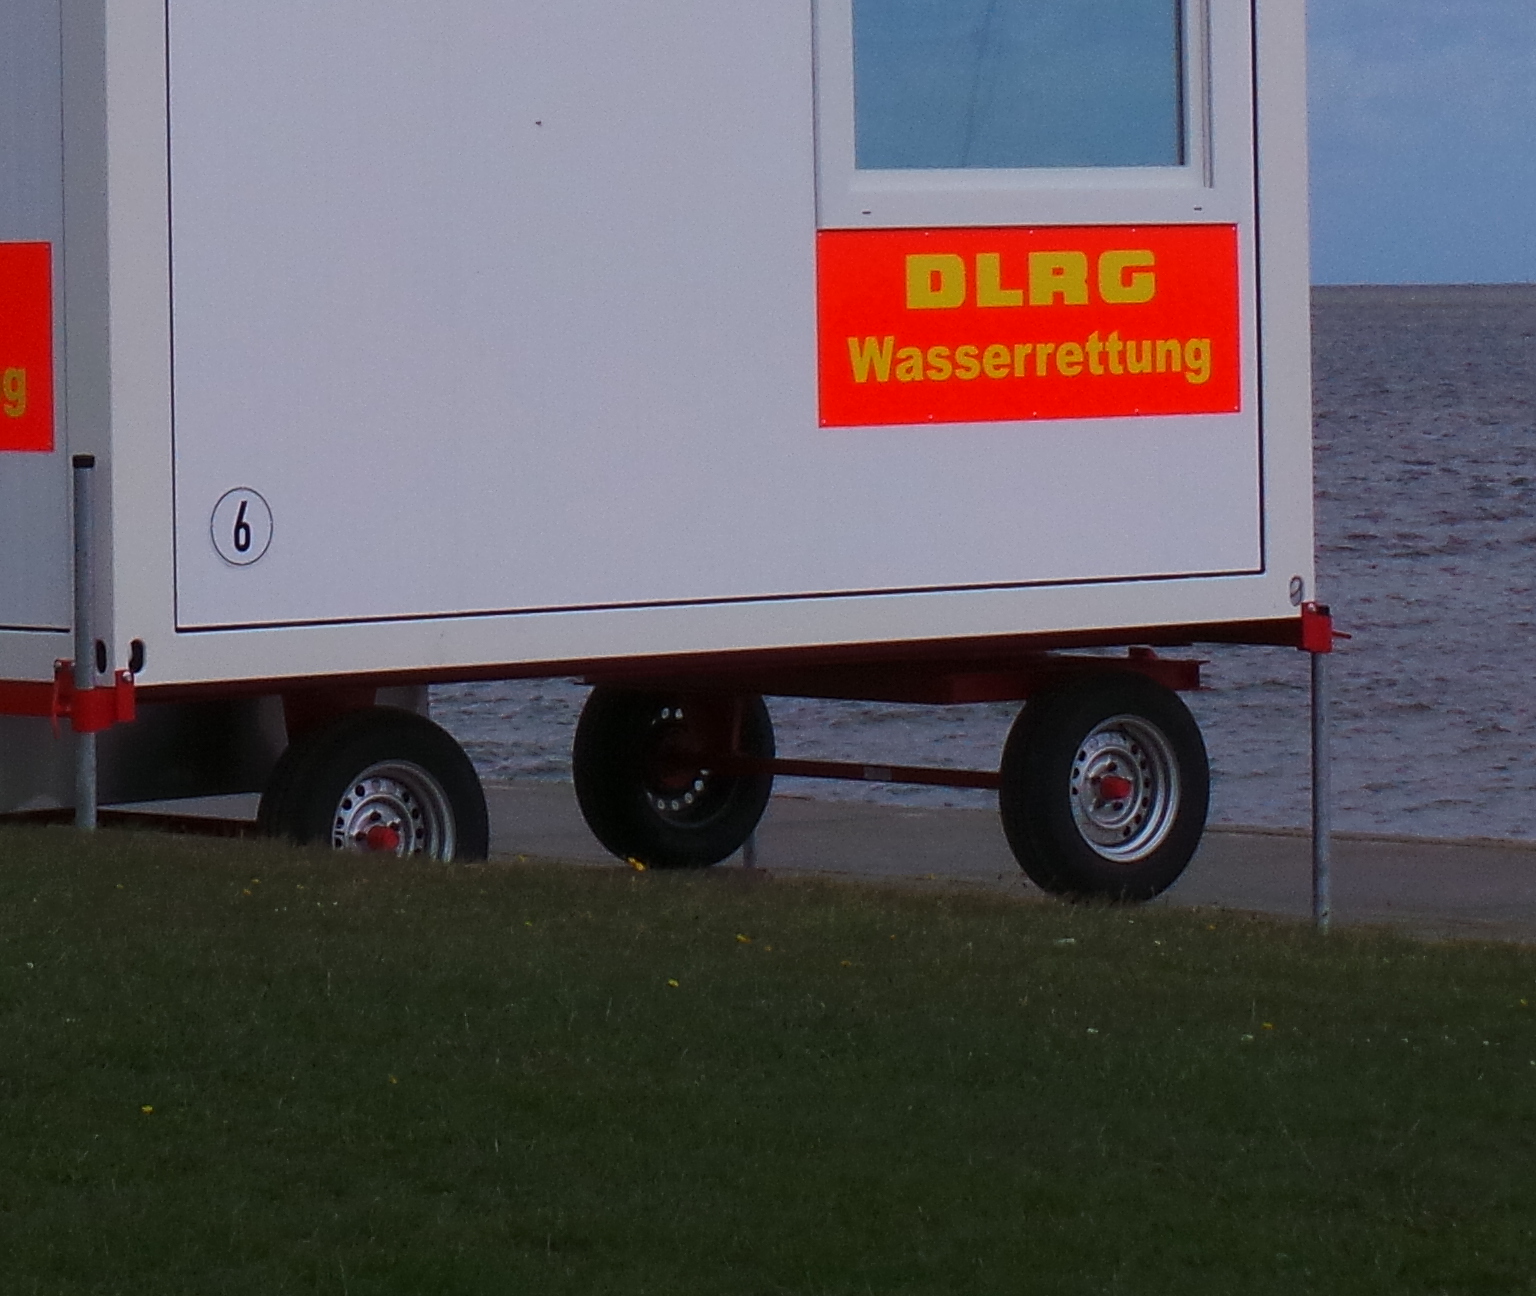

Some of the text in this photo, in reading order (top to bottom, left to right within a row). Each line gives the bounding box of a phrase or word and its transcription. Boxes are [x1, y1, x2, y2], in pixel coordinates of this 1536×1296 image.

[905, 250, 1155, 309] DLRG
[849, 330, 1212, 384] Wasserrettung
[234, 500, 251, 552] 6
